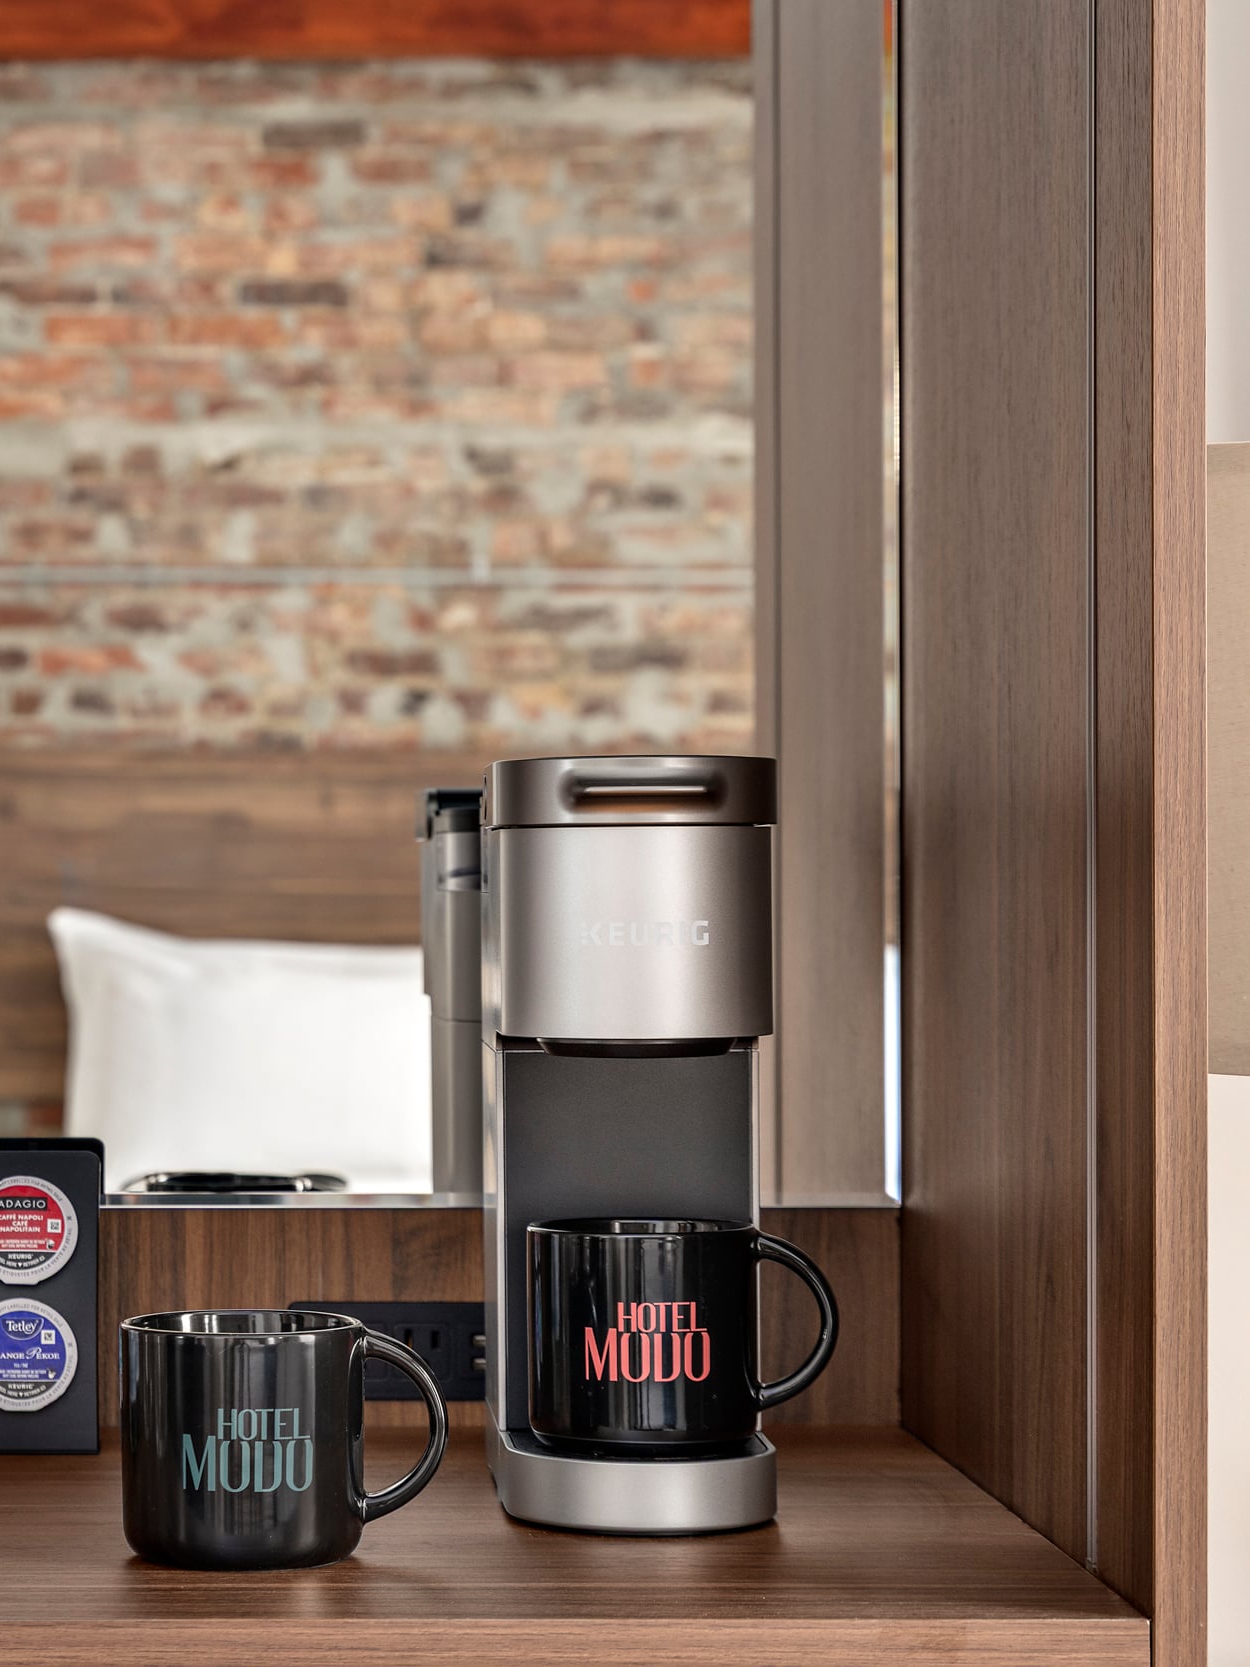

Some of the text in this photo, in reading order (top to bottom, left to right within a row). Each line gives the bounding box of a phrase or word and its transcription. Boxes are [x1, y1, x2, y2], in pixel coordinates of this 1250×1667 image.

[581, 920, 710, 946] KEURIG
[6, 1320, 37, 1335] Tetley
[617, 1301, 708, 1333] HOTEL
[584, 1326, 711, 1383] MODO
[217, 1407, 311, 1441] HOTEL
[182, 1433, 314, 1493] MODO
